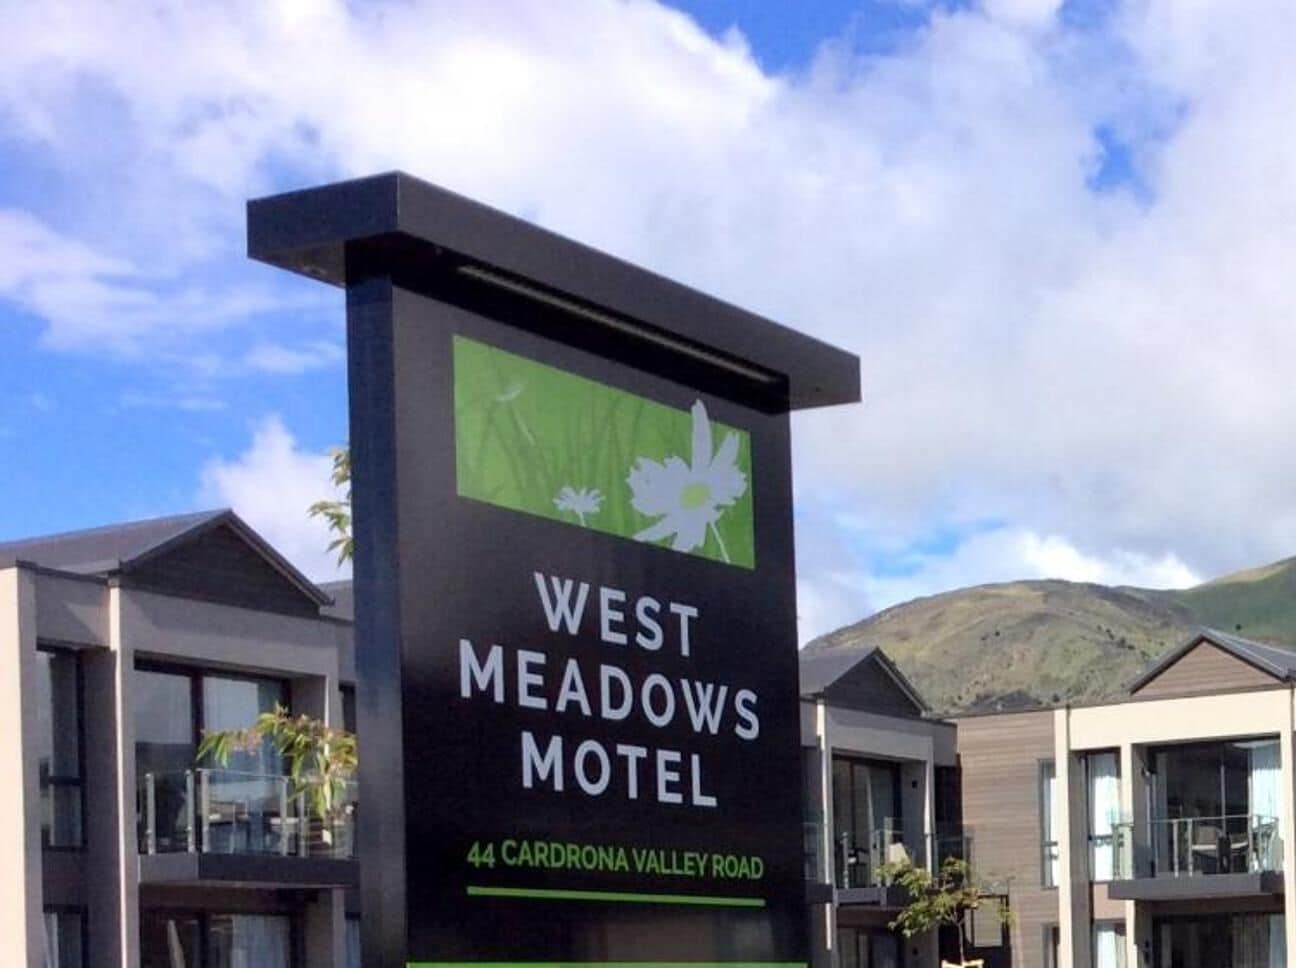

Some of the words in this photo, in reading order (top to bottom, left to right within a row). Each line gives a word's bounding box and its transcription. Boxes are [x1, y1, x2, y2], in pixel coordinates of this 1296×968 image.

[534, 572, 698, 656] WEST
[459, 639, 760, 740] MEADOWS
[521, 732, 718, 808] MOTEL
[467, 842, 495, 866] 44
[501, 840, 628, 871] CARDRONA
[634, 849, 708, 877] VALLEY
[713, 854, 763, 878] ROAD
